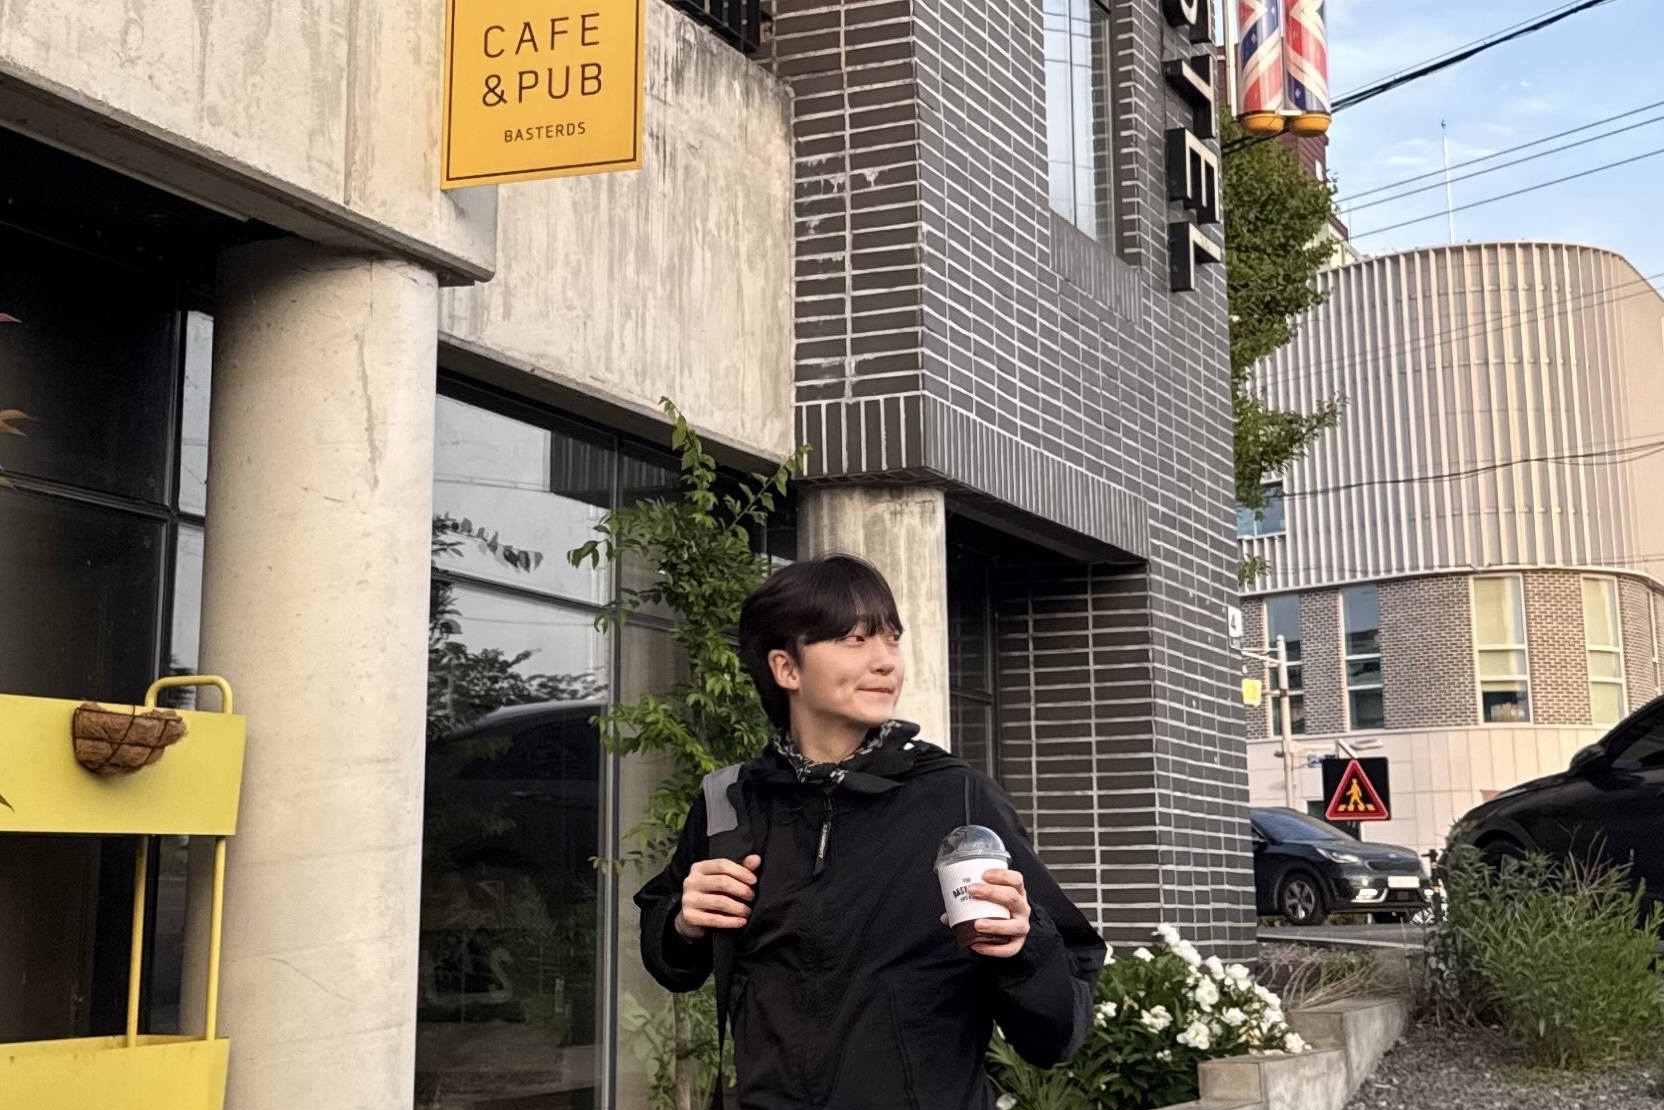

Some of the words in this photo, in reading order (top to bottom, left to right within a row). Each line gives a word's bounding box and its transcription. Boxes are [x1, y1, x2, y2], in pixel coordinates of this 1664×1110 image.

[483, 12, 600, 58] CAFE
[482, 62, 602, 107] &PUB
[504, 121, 586, 143] BASTERDS
